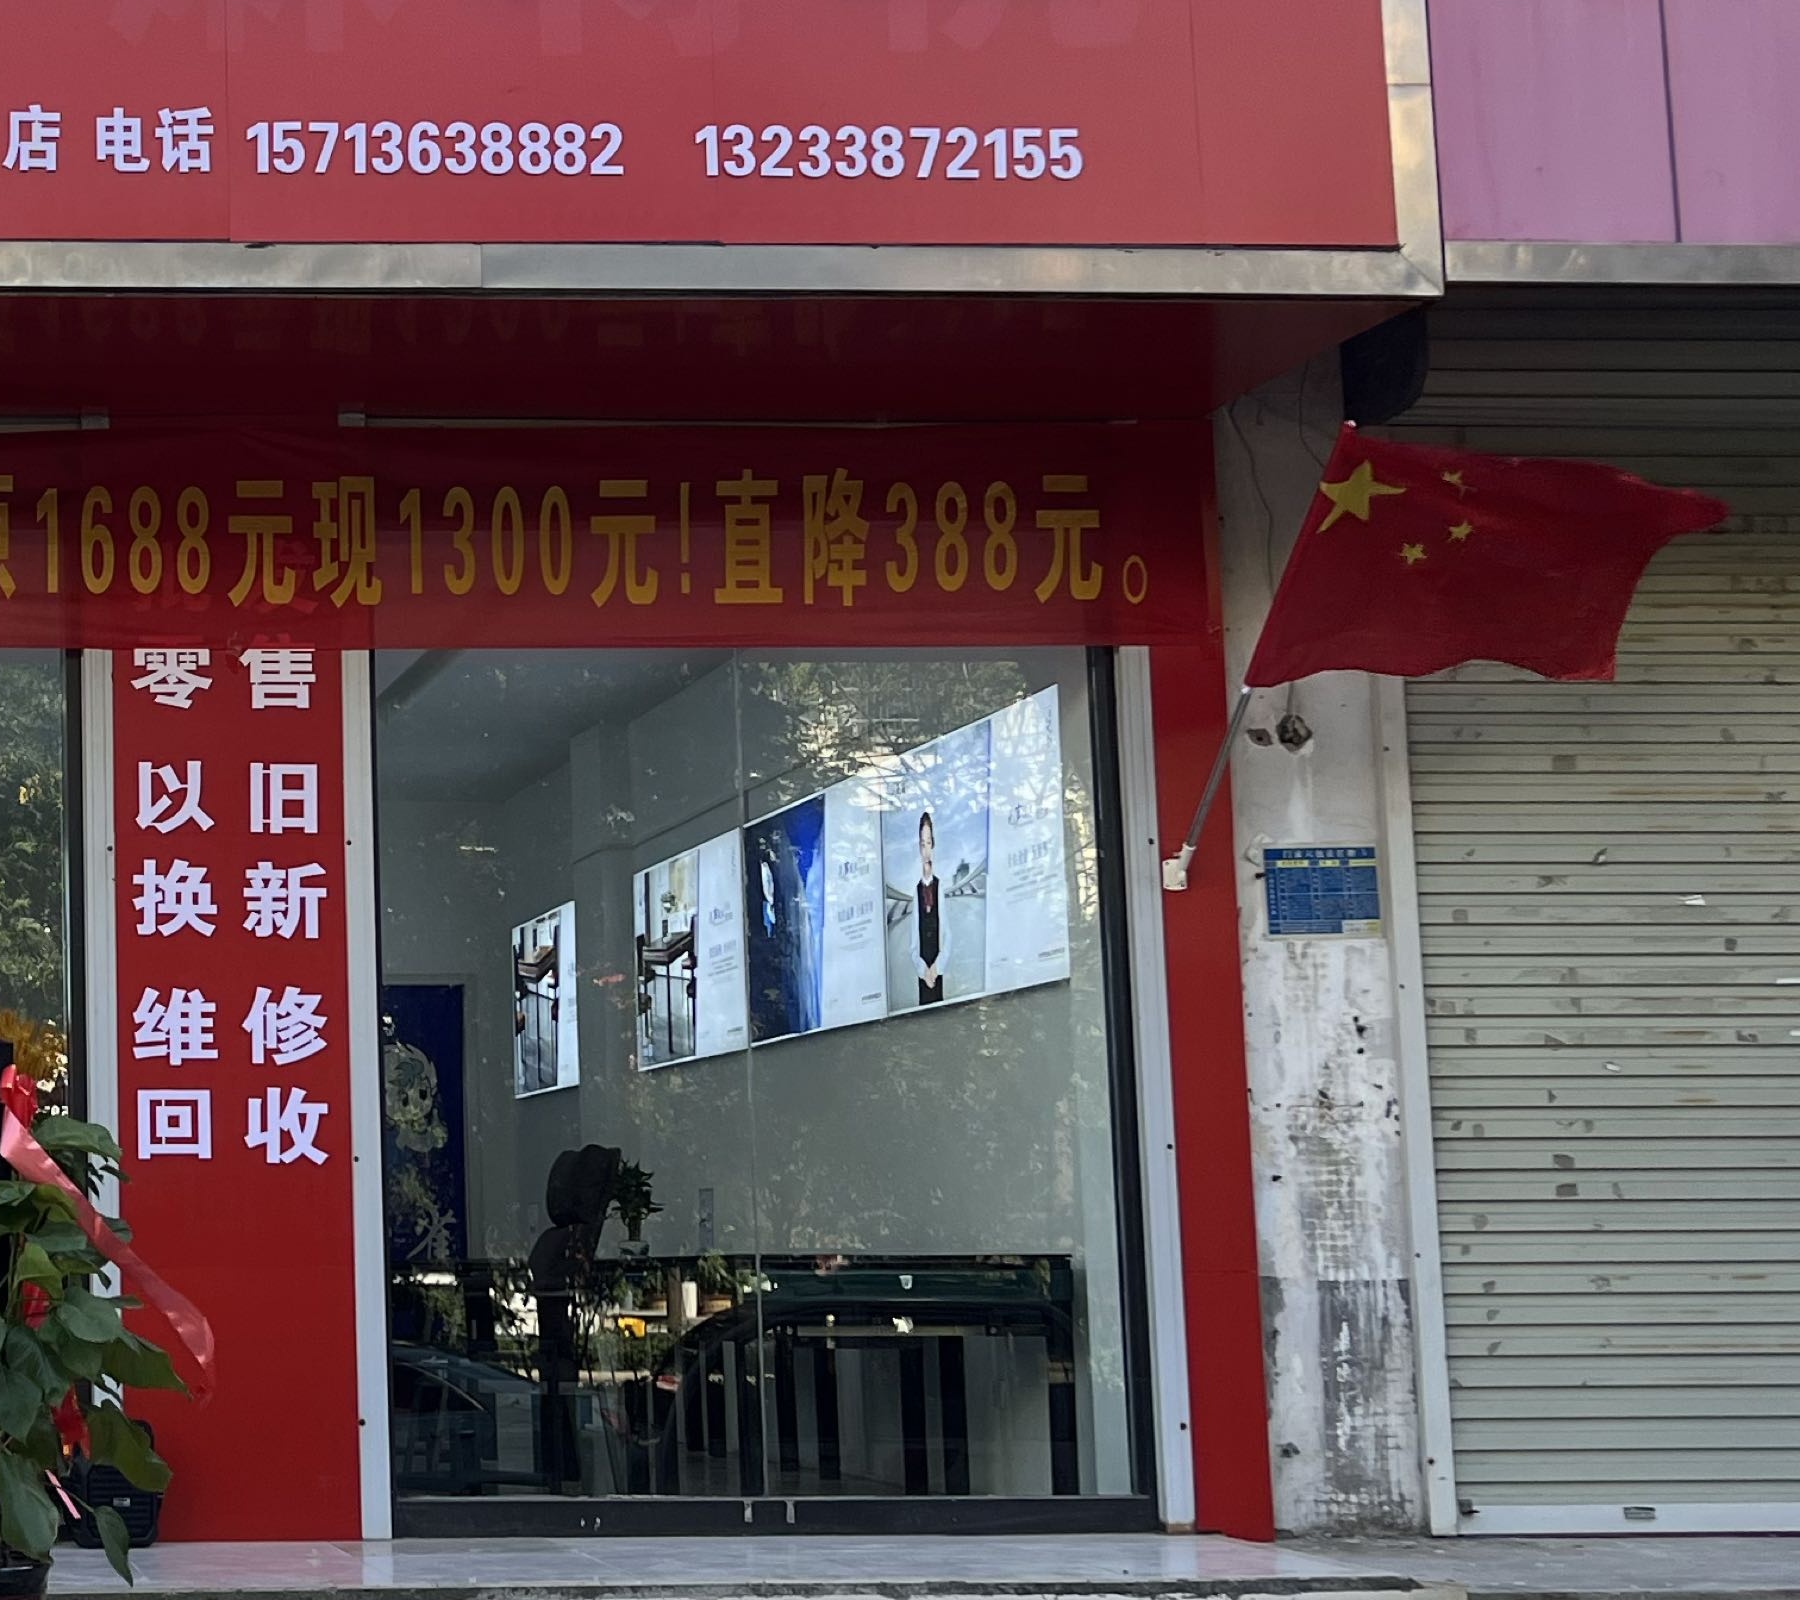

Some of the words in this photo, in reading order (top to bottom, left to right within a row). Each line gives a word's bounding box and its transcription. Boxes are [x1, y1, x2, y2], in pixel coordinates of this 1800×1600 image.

[96, 108, 214, 174] 电话
[246, 121, 624, 177] 15713638882
[694, 124, 1083, 180] 13233872155
[130, 648, 317, 710] 零售
[136, 761, 320, 835] 以旧
[132, 860, 328, 940] 换新
[132, 986, 328, 1068] 维修
[136, 1086, 330, 1166] 回收
